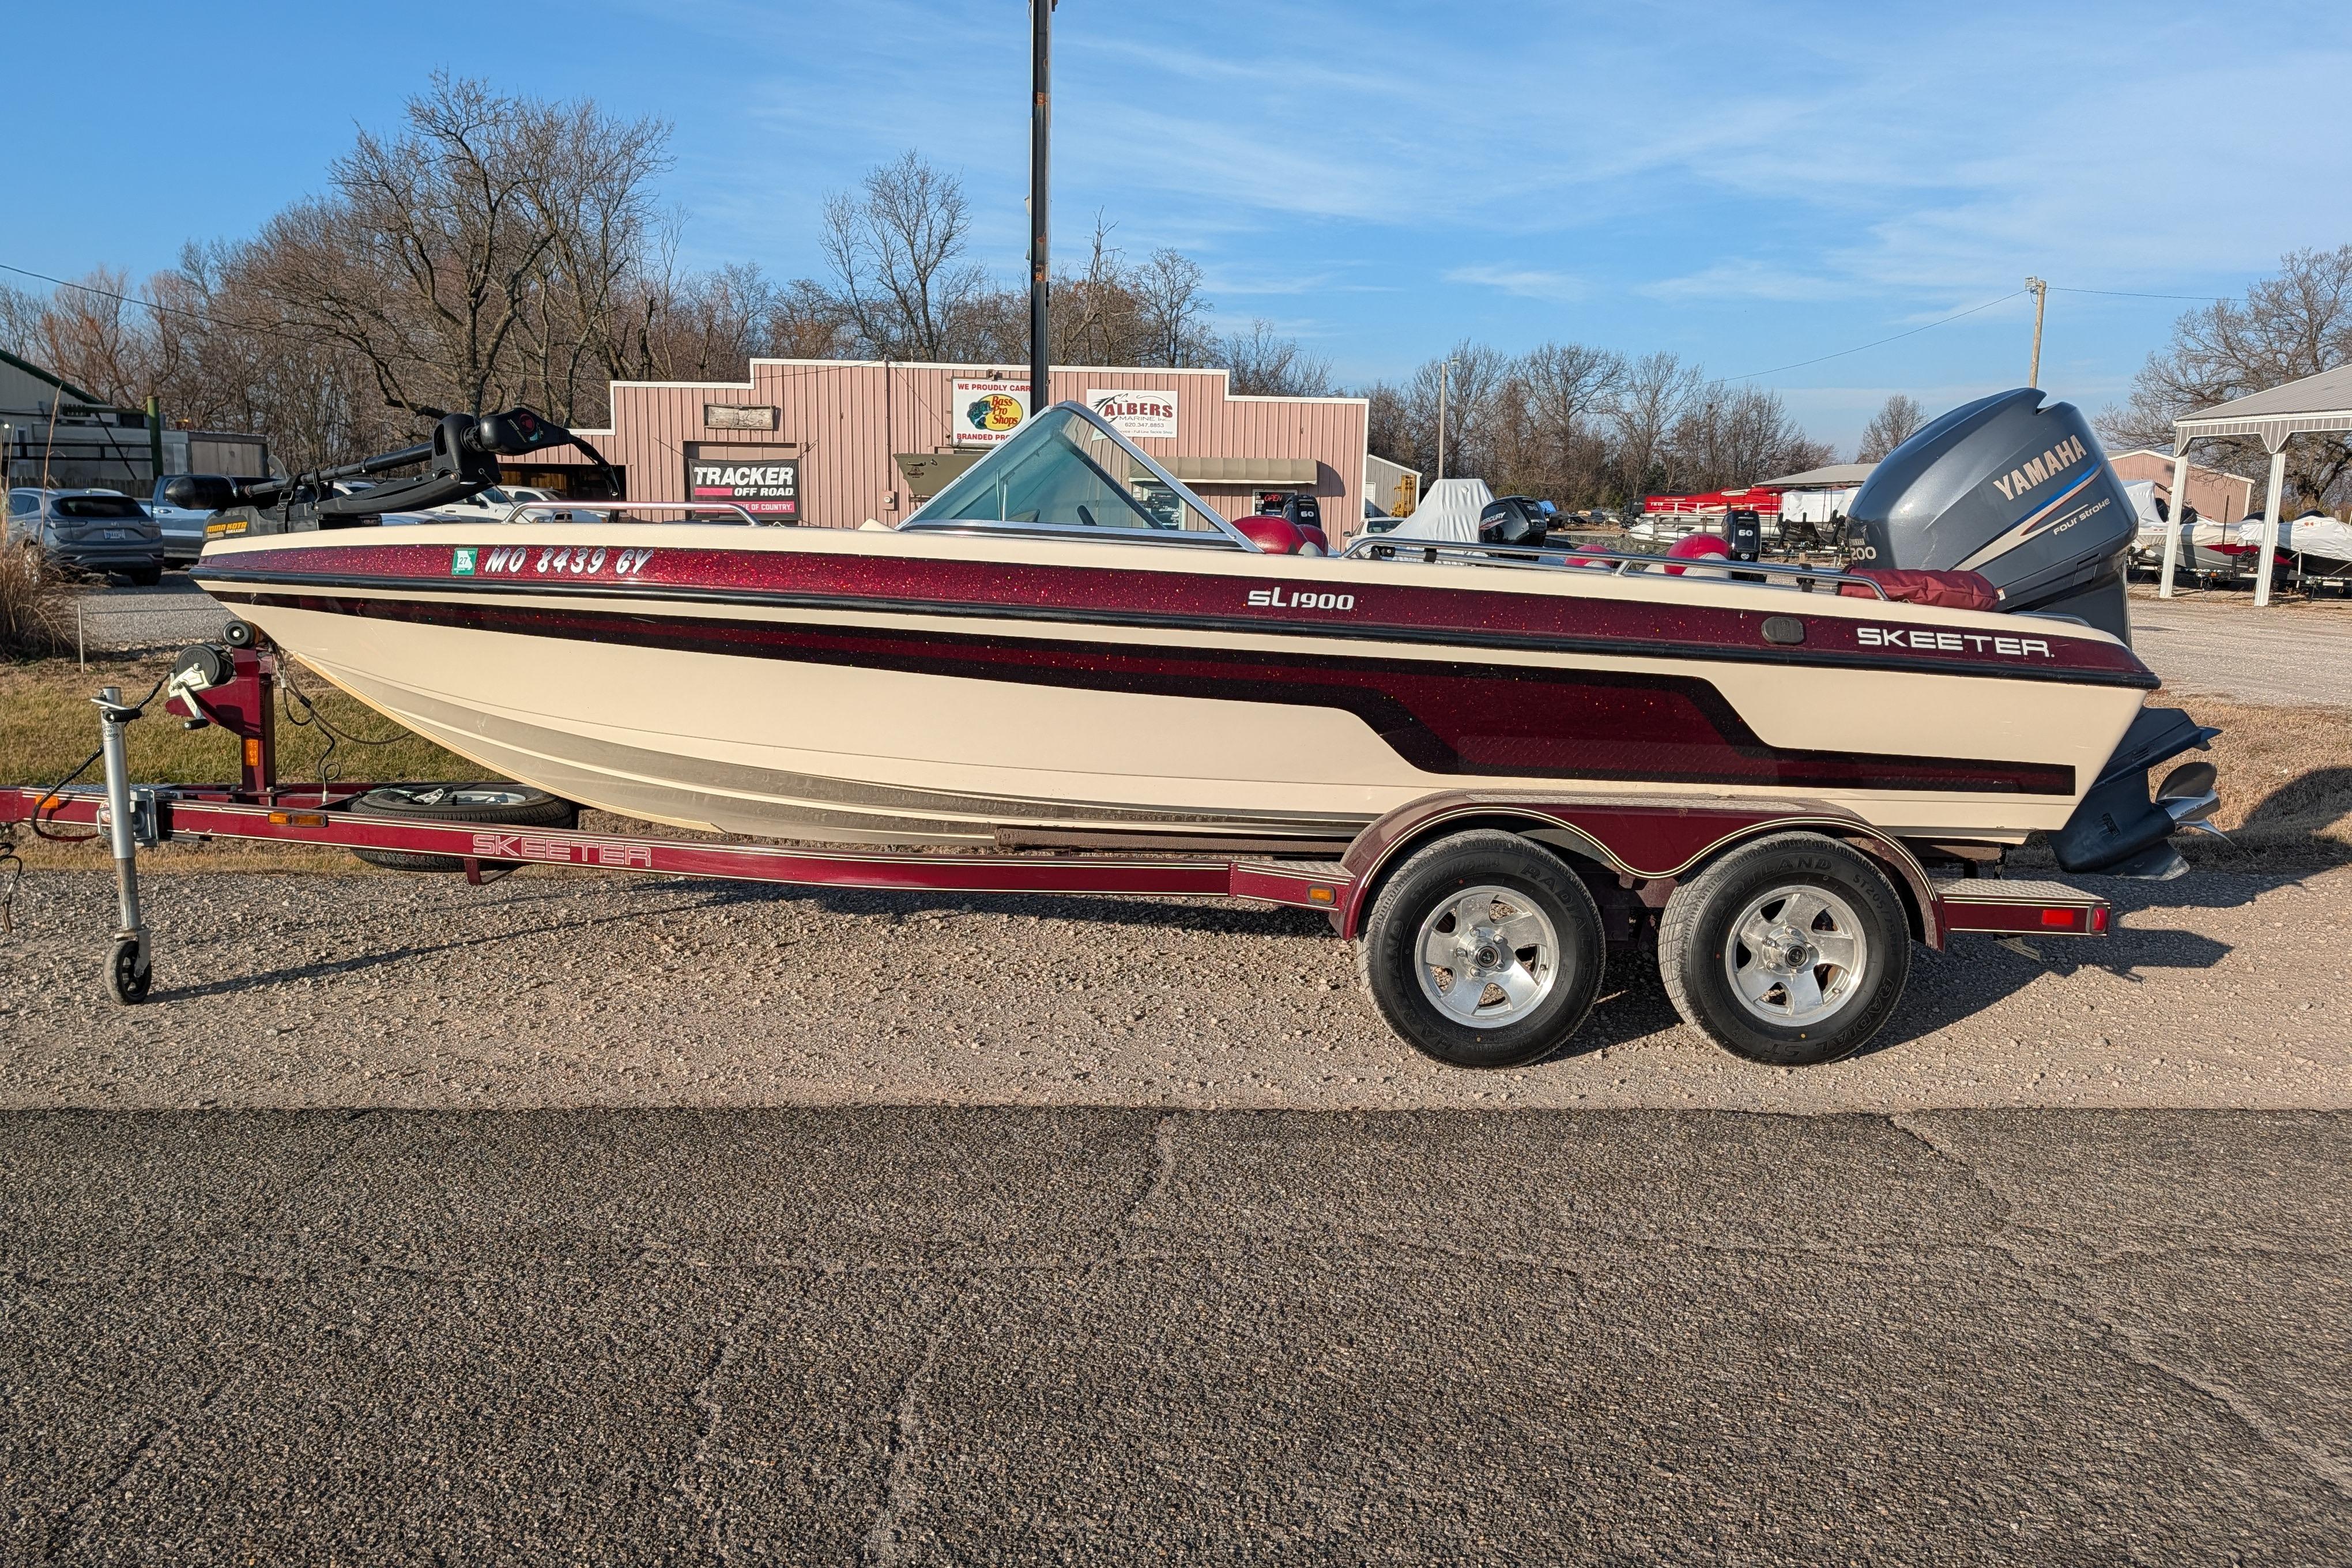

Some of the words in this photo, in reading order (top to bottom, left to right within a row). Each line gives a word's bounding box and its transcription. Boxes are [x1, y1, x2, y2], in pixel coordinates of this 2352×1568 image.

[992, 396, 1013, 406] Bass
[992, 406, 1008, 415] Pro
[1103, 402, 1173, 418] ALBERS
[992, 415, 1018, 427] Shops
[693, 467, 794, 485] TRACKER
[1993, 435, 2087, 501] YAMAHA
[734, 487, 757, 496] OFF
[1480, 512, 1506, 524] MERCURY
[459, 557, 468, 565] 27
[485, 548, 526, 573] MO
[537, 548, 606, 574] 8439
[616, 549, 654, 574] GY
[1850, 546, 1876, 560] 200
[1247, 587, 1287, 607] SL
[1291, 592, 1355, 610] 1900
[1857, 627, 2051, 657] SKEETER
[473, 834, 651, 867] SKEETER
[1520, 864, 1590, 948] RADIAL
